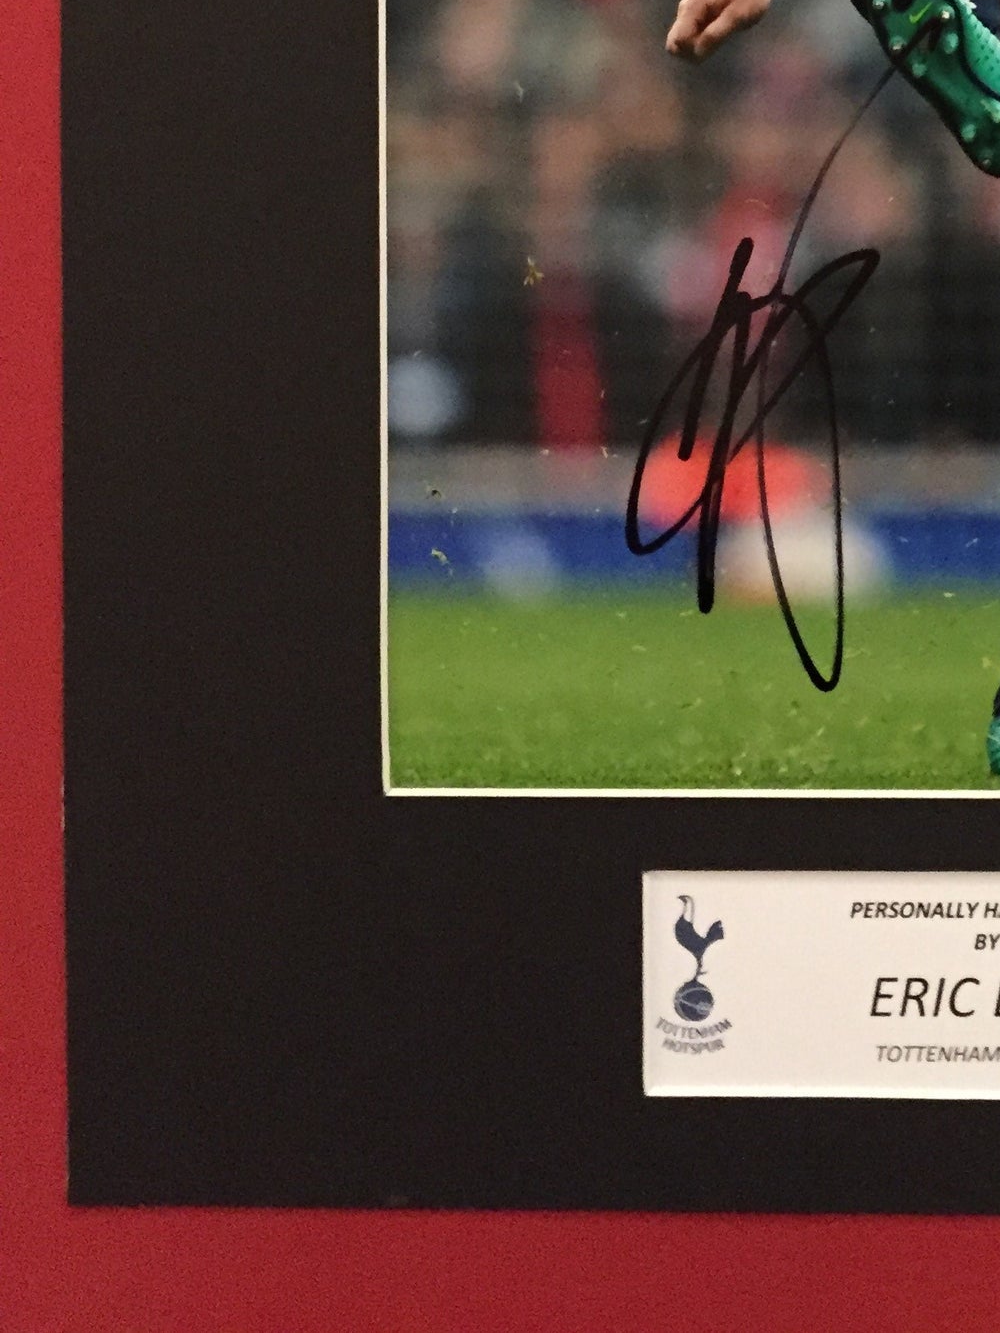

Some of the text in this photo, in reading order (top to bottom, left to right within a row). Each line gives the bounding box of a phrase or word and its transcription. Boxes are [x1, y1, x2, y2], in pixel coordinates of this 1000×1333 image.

[850, 901, 979, 920] PERSONALLY
[974, 933, 1000, 952] BY
[870, 977, 979, 1018] ERIC
[876, 1044, 1000, 1064] TOTTENHAM
